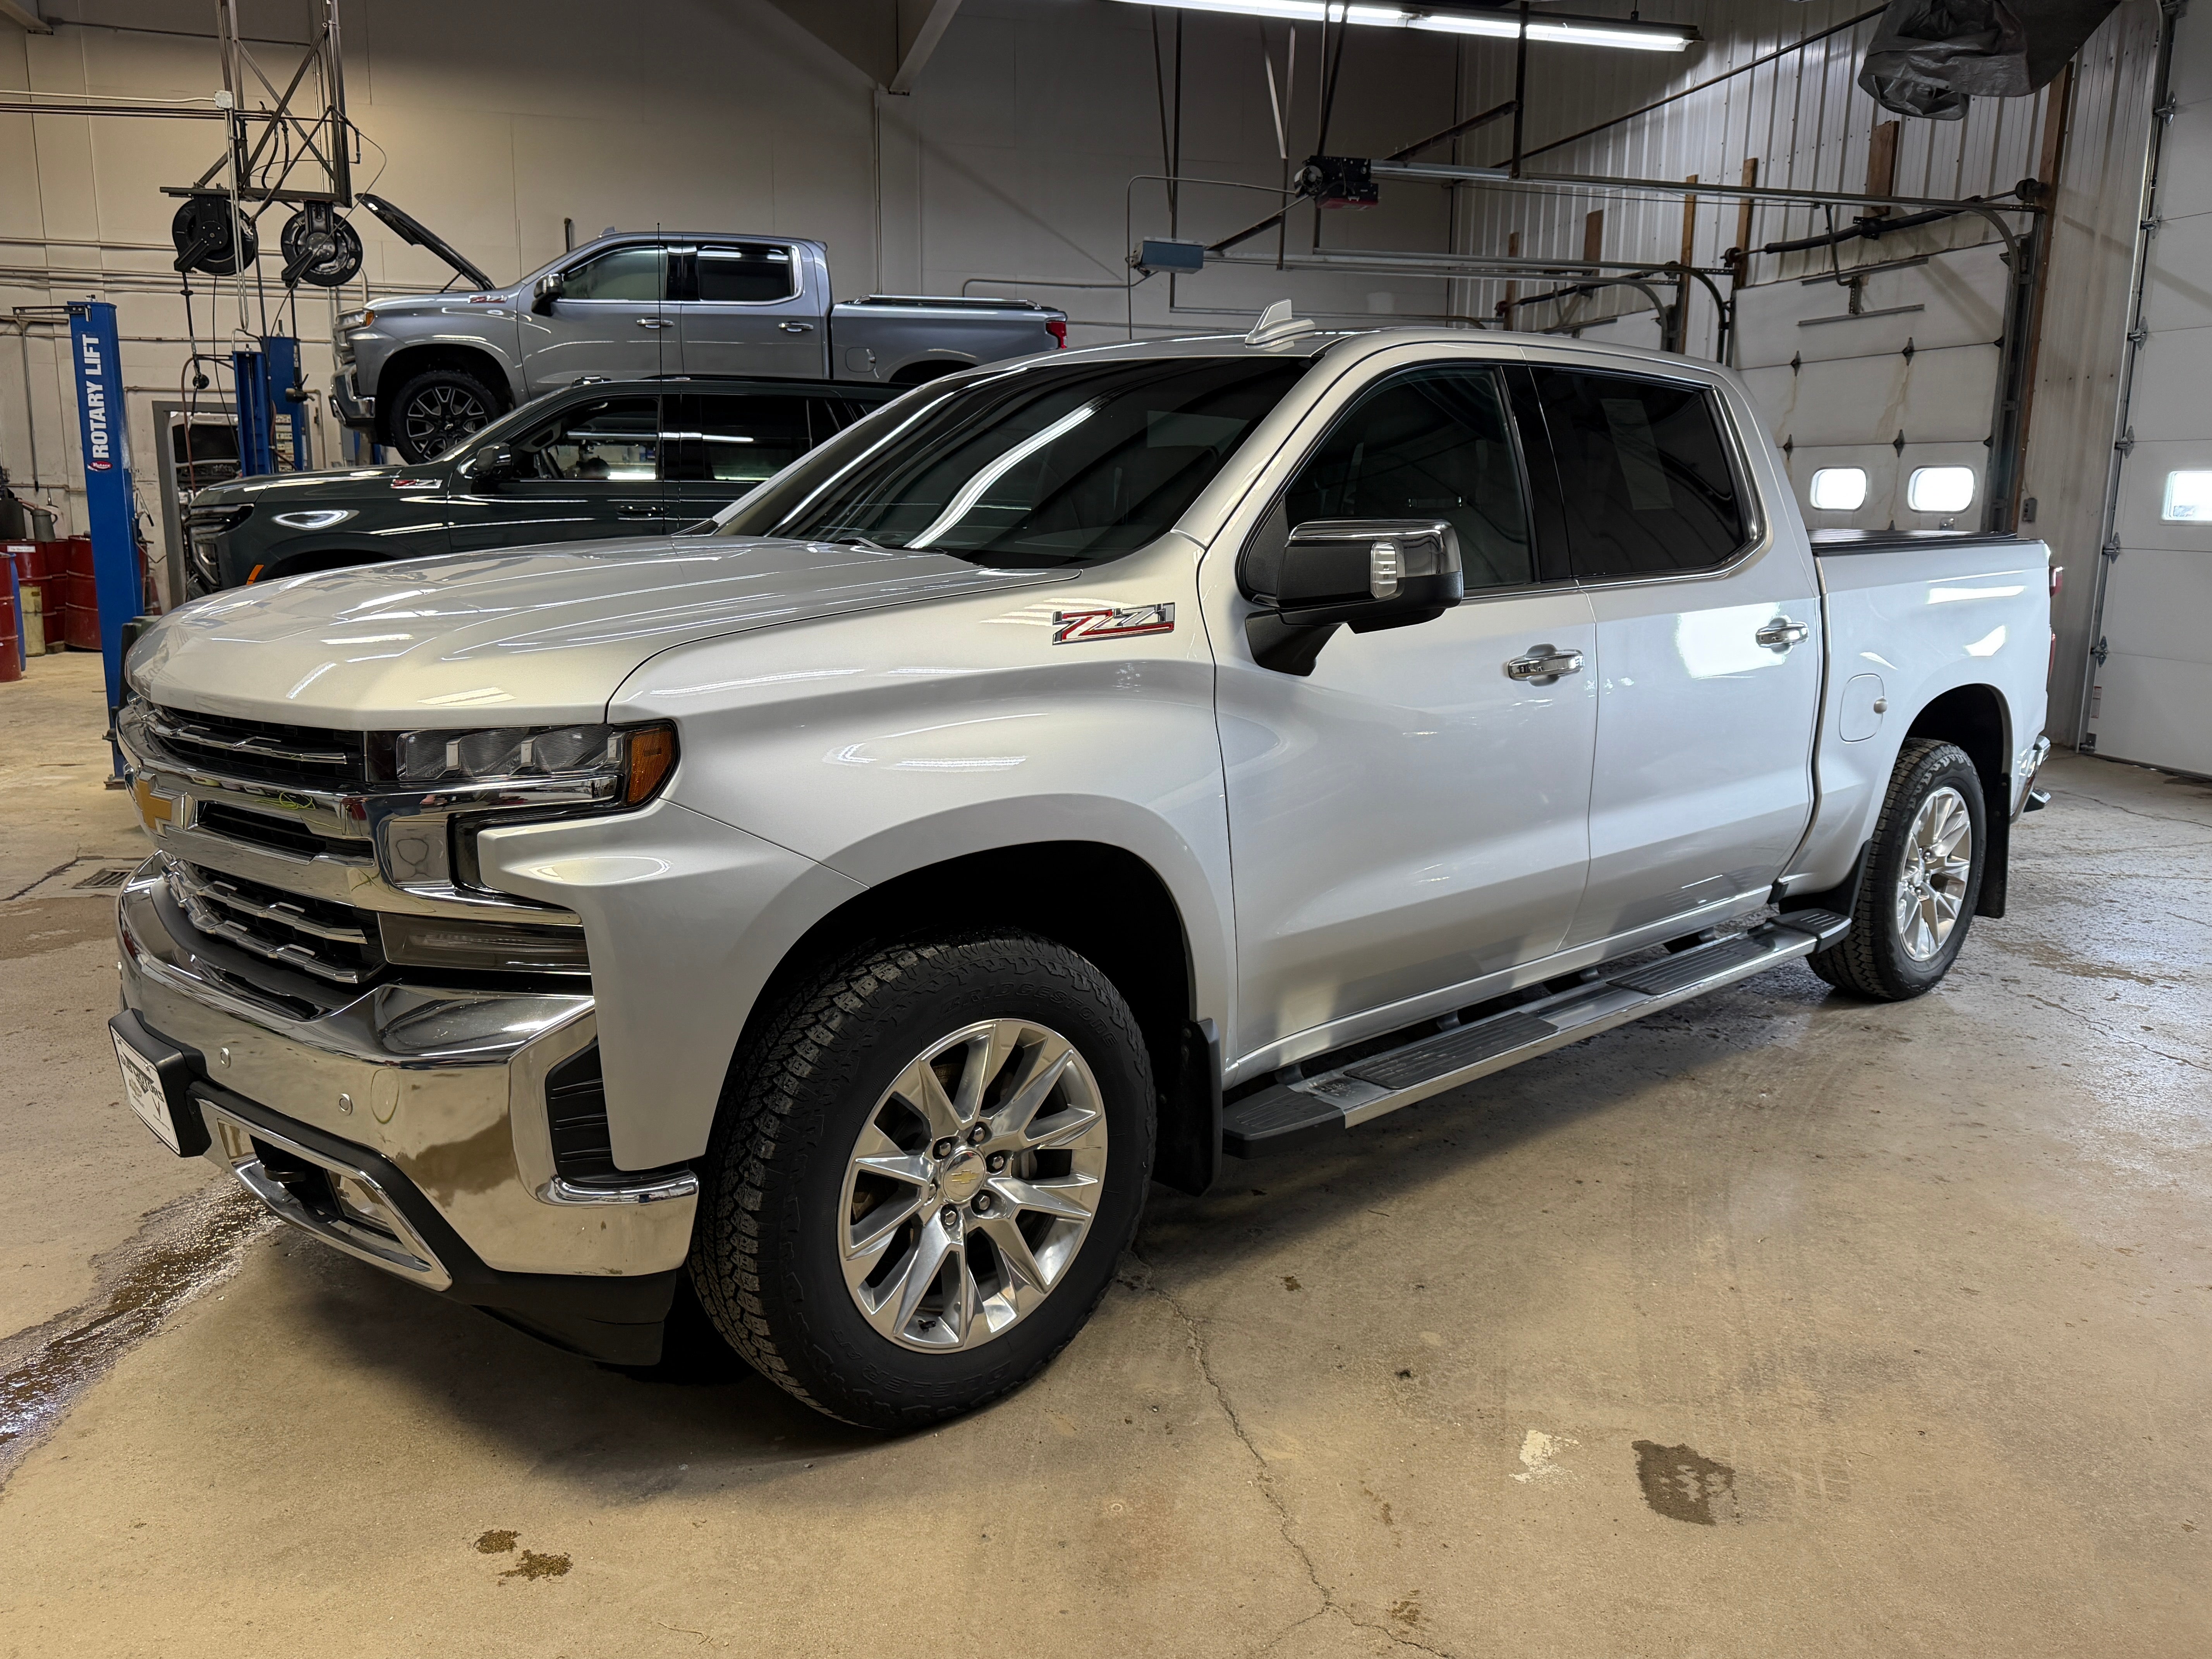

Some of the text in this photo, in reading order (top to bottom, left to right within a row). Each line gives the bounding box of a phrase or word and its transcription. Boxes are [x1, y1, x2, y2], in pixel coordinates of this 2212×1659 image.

[82, 334, 102, 375] LIFT
[86, 380, 110, 458] ROTARY
[1052, 601, 1176, 646] Z71
[940, 981, 1118, 1047] BRIDGESTONE
[133, 1067, 165, 1103] MOTORS
